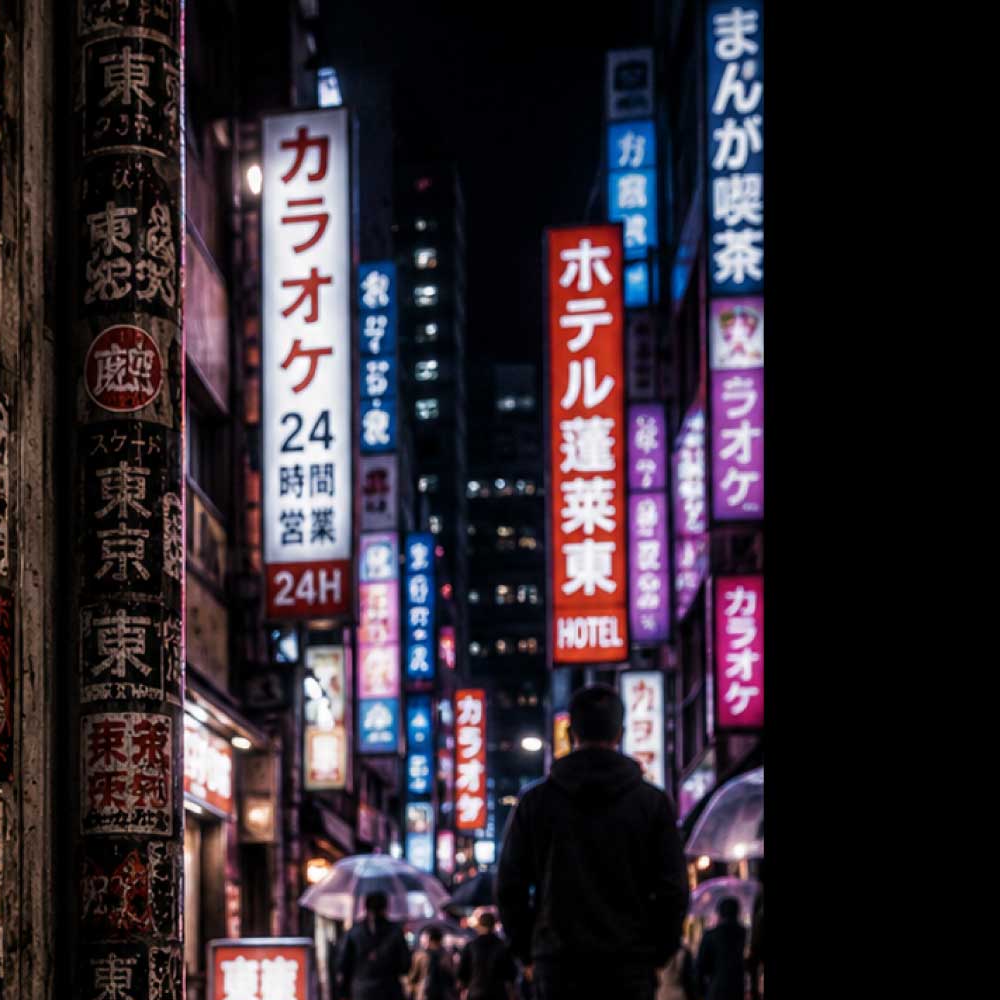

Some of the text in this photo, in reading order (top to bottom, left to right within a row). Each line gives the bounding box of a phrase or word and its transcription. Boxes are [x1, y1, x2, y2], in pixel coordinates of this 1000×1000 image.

[712, 6, 763, 284] まんが喫茶
[279, 125, 334, 394] カラオケ
[279, 410, 335, 453] 24
[279, 463, 335, 499] 時間
[719, 376, 761, 506] ラオケ
[94, 459, 152, 582] 東京
[279, 506, 337, 546] 営業
[273, 568, 343, 607] 24H
[557, 615, 624, 650] HOTEL
[724, 585, 762, 716] カラオケ
[456, 693, 487, 823] カラオケ
